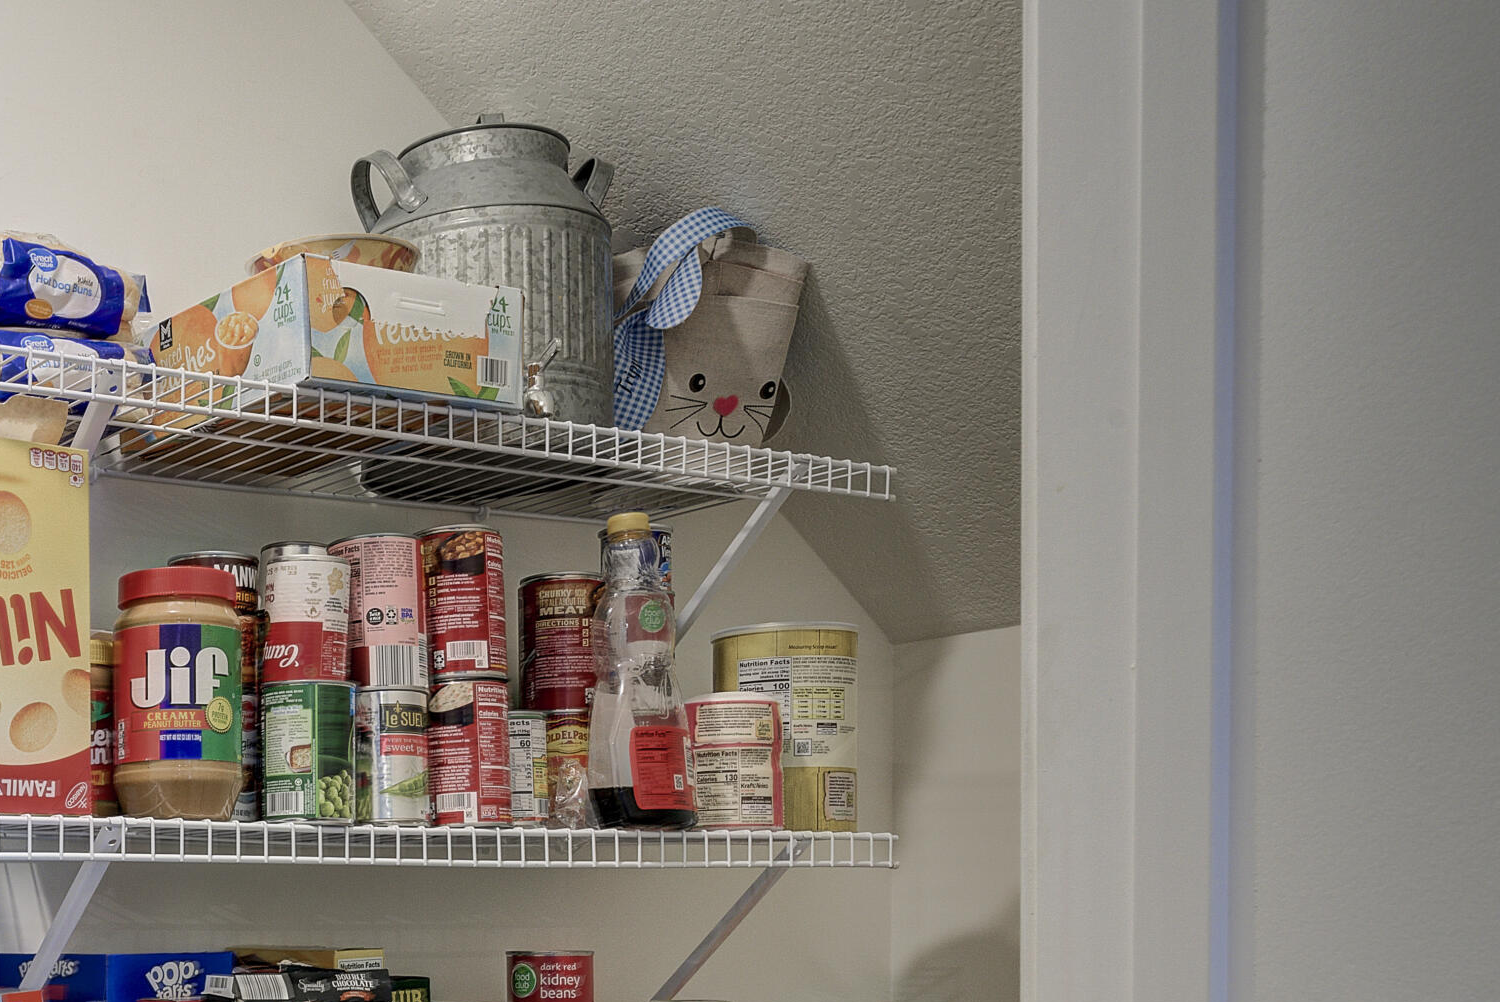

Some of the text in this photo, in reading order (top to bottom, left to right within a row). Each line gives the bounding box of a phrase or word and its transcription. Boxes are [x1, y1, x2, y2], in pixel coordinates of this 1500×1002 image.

[31, 253, 53, 264] Great
[35, 273, 93, 297] Hot Dog Buns
[274, 283, 291, 305] 24
[445, 350, 464, 361] GROWN
[443, 358, 473, 370] CALIFORNIA
[539, 589, 572, 600] CHUNKY
[539, 605, 587, 617] MEAT
[535, 620, 580, 628] DIRECTIONS
[739, 658, 790, 669] Nutrition Facts
[130, 646, 229, 709] Jif
[772, 682, 790, 691] 100
[146, 711, 196, 721] CREAMY
[385, 710, 399, 728] Le
[143, 719, 201, 728] PEANUT BUTTER
[385, 743, 415, 753] sweet
[696, 751, 720, 759] Nutrition
[696, 775, 718, 783] Calories
[340, 960, 381, 970] Nutrition Facts
[540, 961, 577, 971] dark red
[335, 973, 366, 981] DOUBLE
[513, 972, 531, 982] food
[539, 973, 581, 989] kidney
[332, 979, 374, 988] CHOCOLATE
[539, 987, 577, 999] beans
